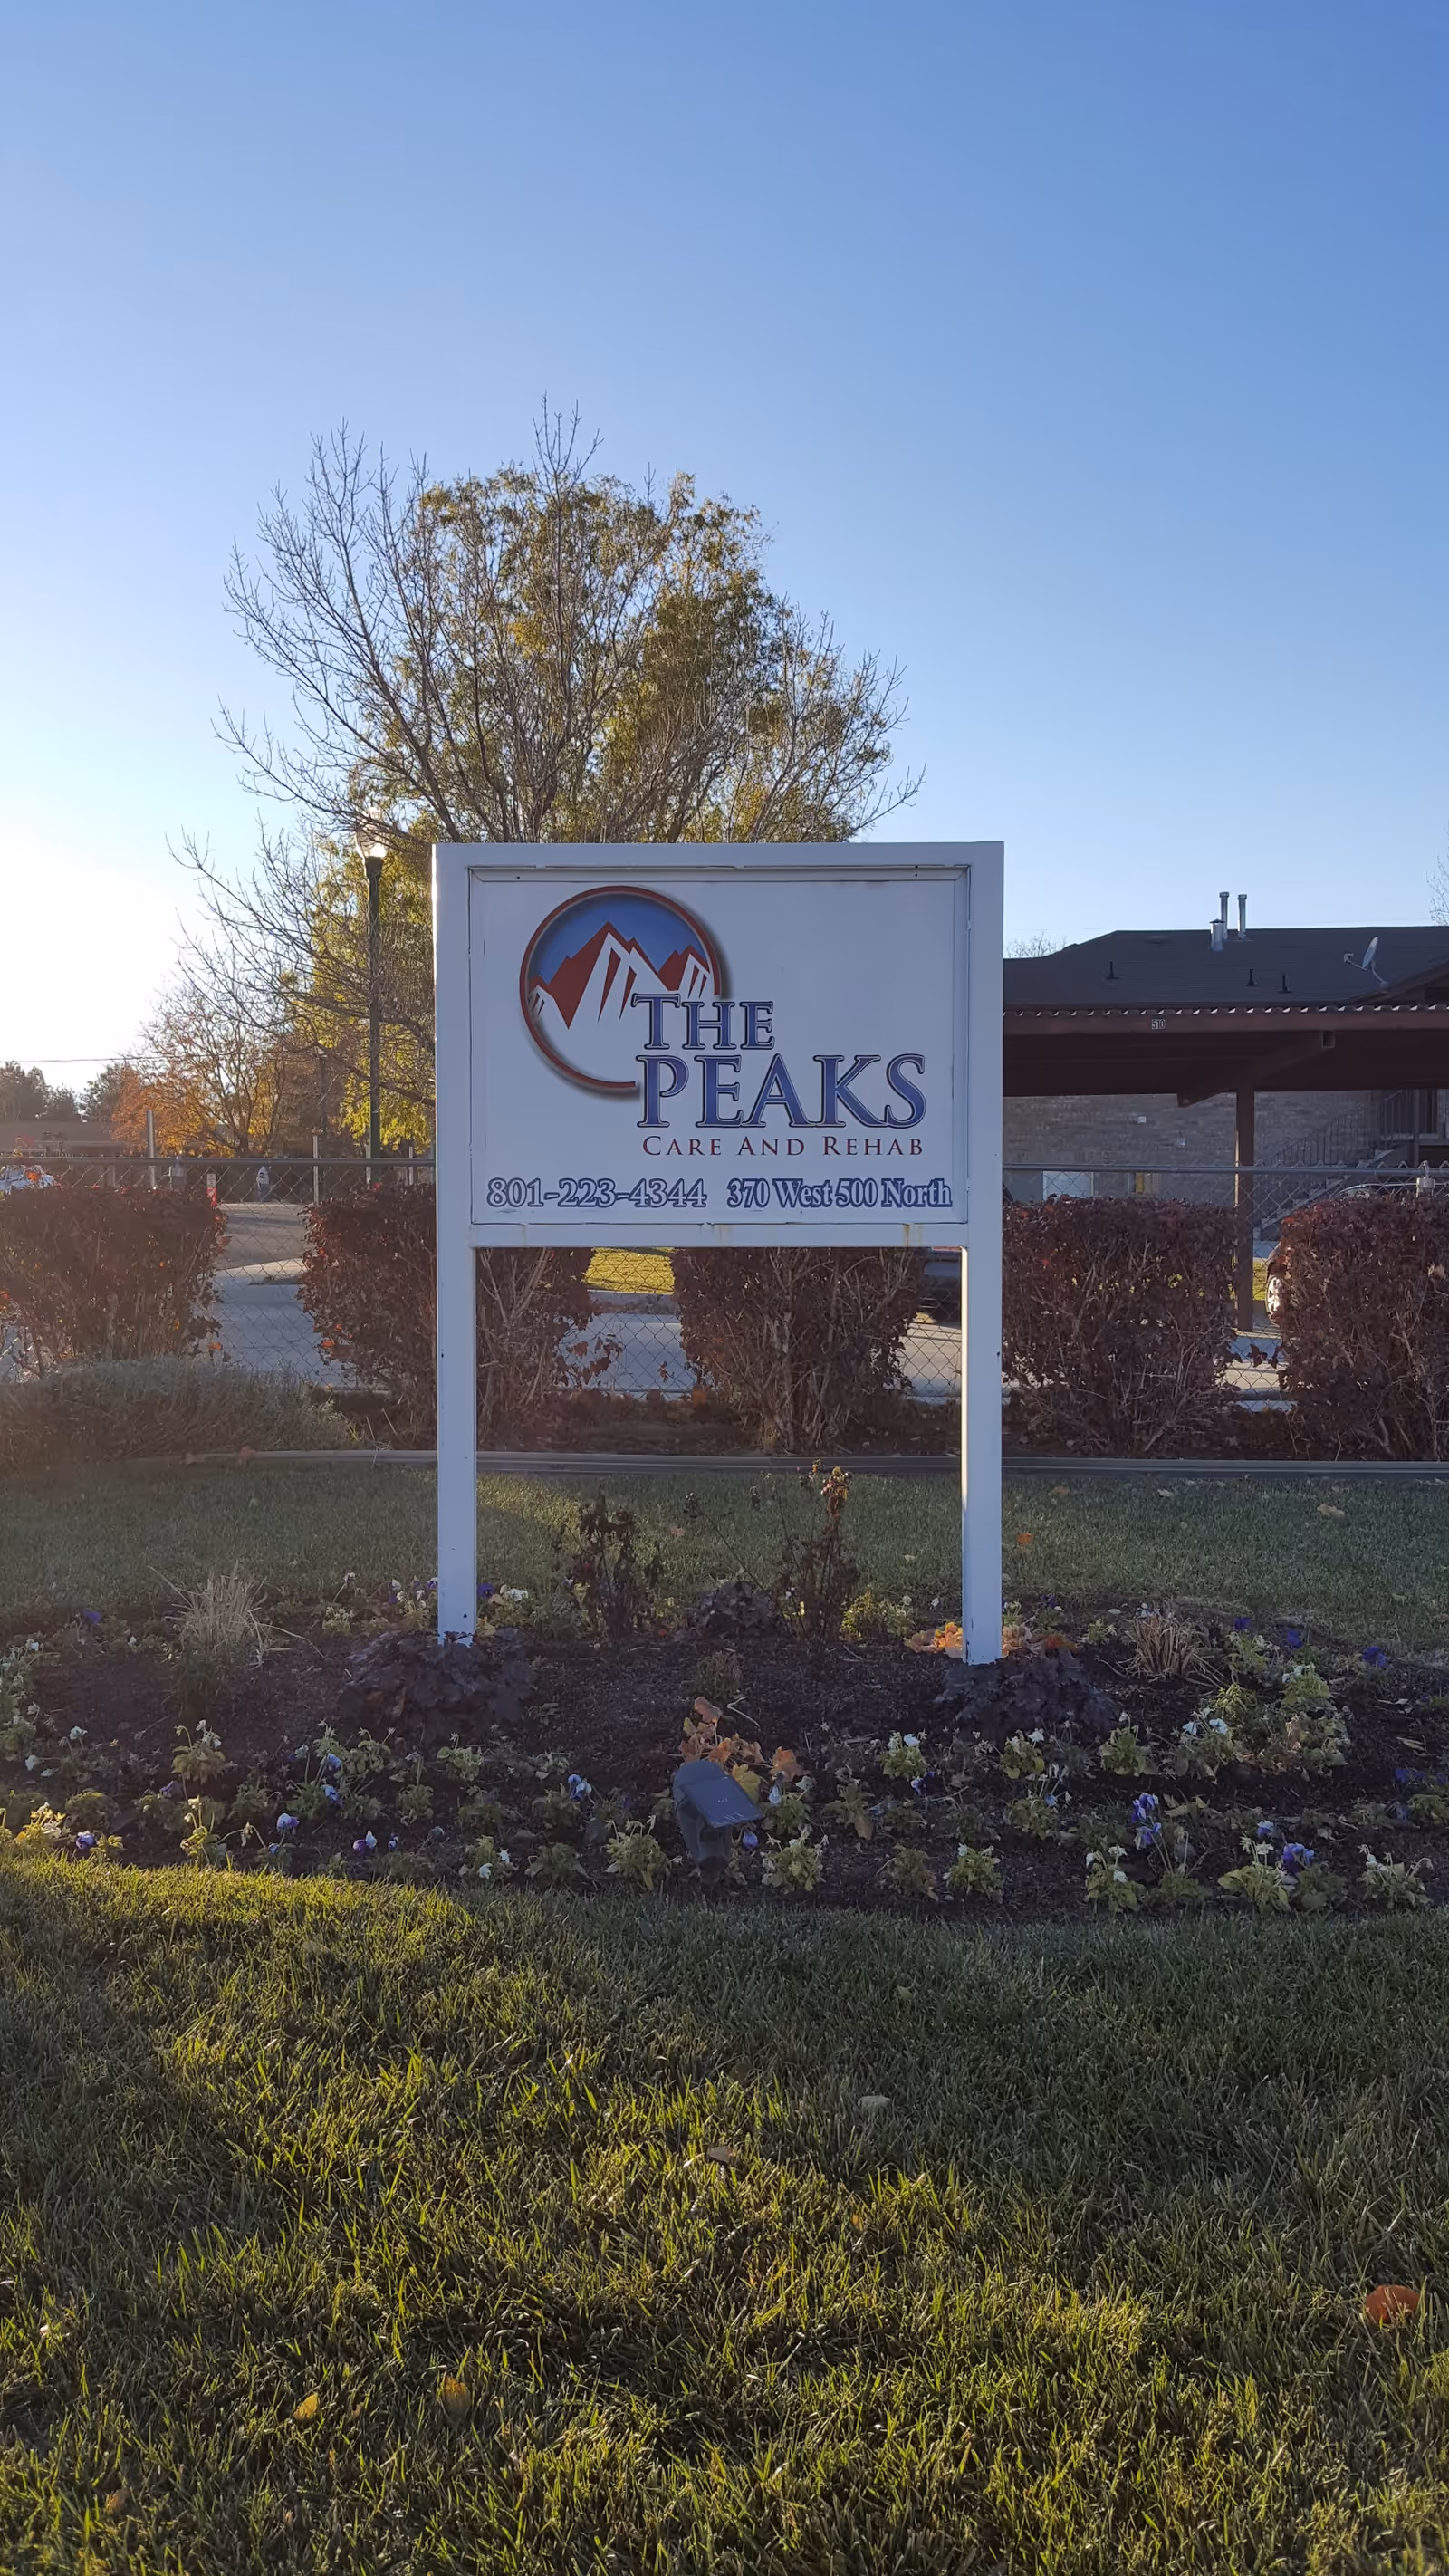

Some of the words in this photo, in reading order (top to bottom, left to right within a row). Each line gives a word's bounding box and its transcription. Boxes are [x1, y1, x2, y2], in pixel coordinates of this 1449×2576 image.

[635, 1053, 927, 1129] PEAKS
[486, 1177, 708, 1208] 801-223-4344
[726, 1177, 770, 1208] 370
[772, 1177, 833, 1208] West
[834, 1177, 878, 1208] 500
[881, 1177, 953, 1208] North
